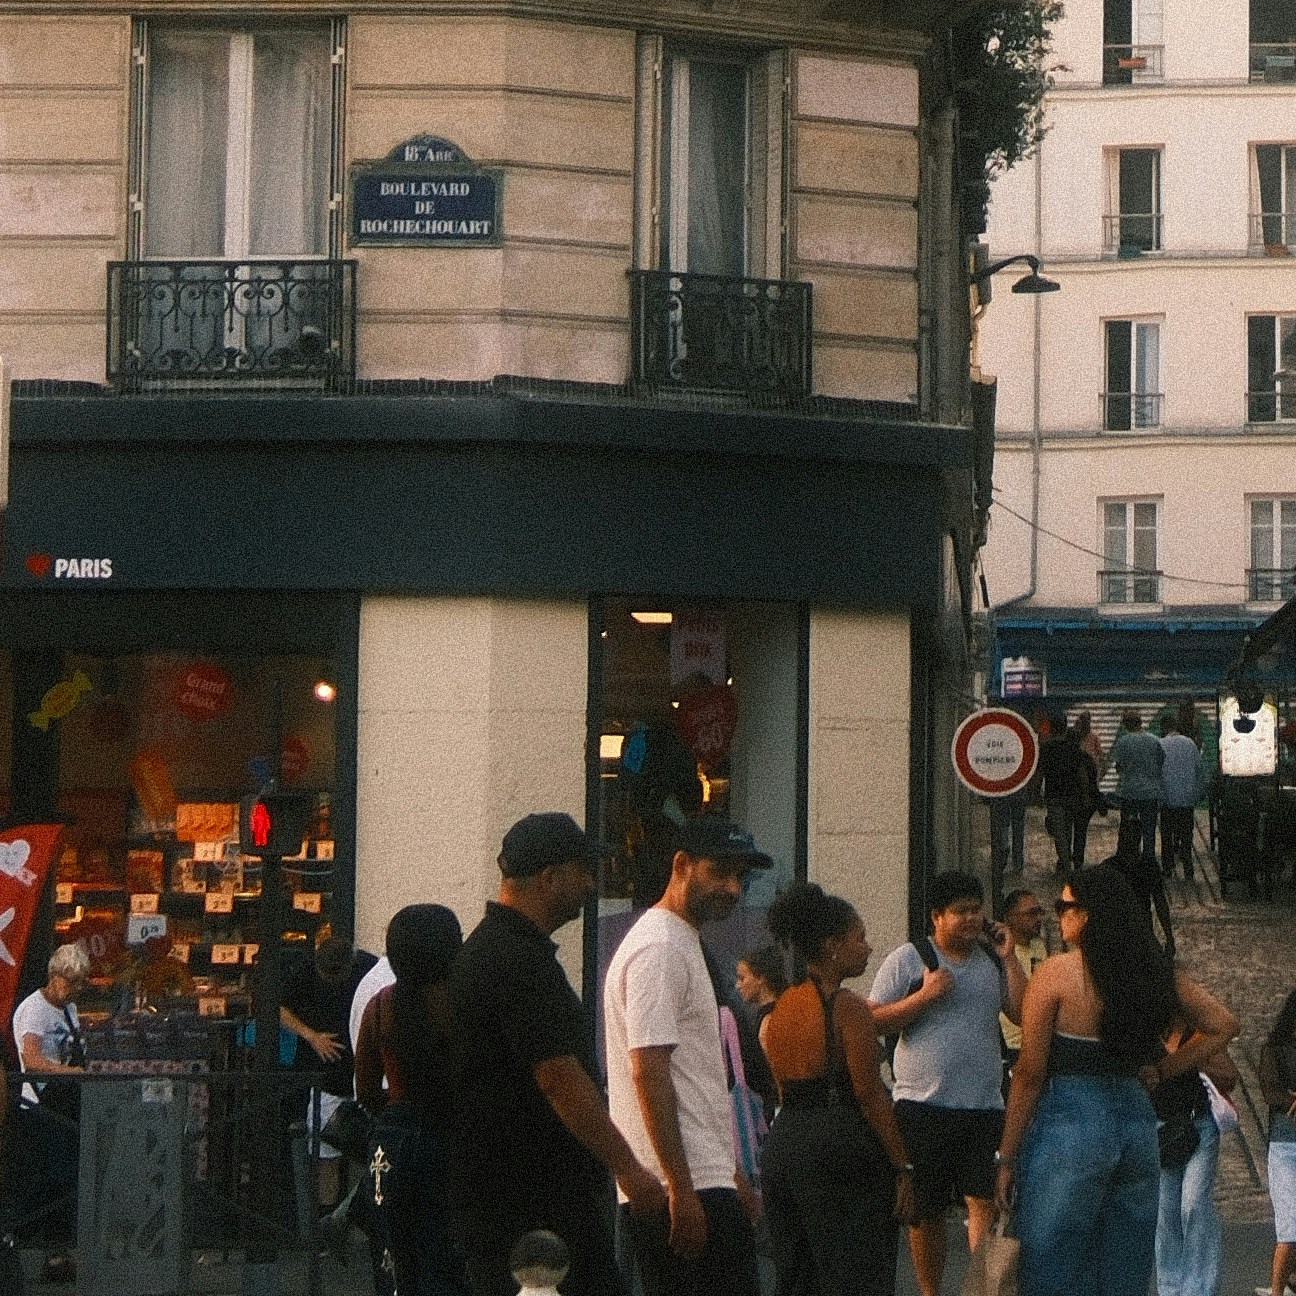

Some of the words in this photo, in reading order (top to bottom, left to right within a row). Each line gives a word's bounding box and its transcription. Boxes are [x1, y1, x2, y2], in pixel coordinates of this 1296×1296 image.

[380, 182, 470, 196] BOULEVARD
[415, 201, 435, 215] DE
[360, 219, 490, 235] ROCHECHOUART
[55, 558, 113, 579] PARIS
